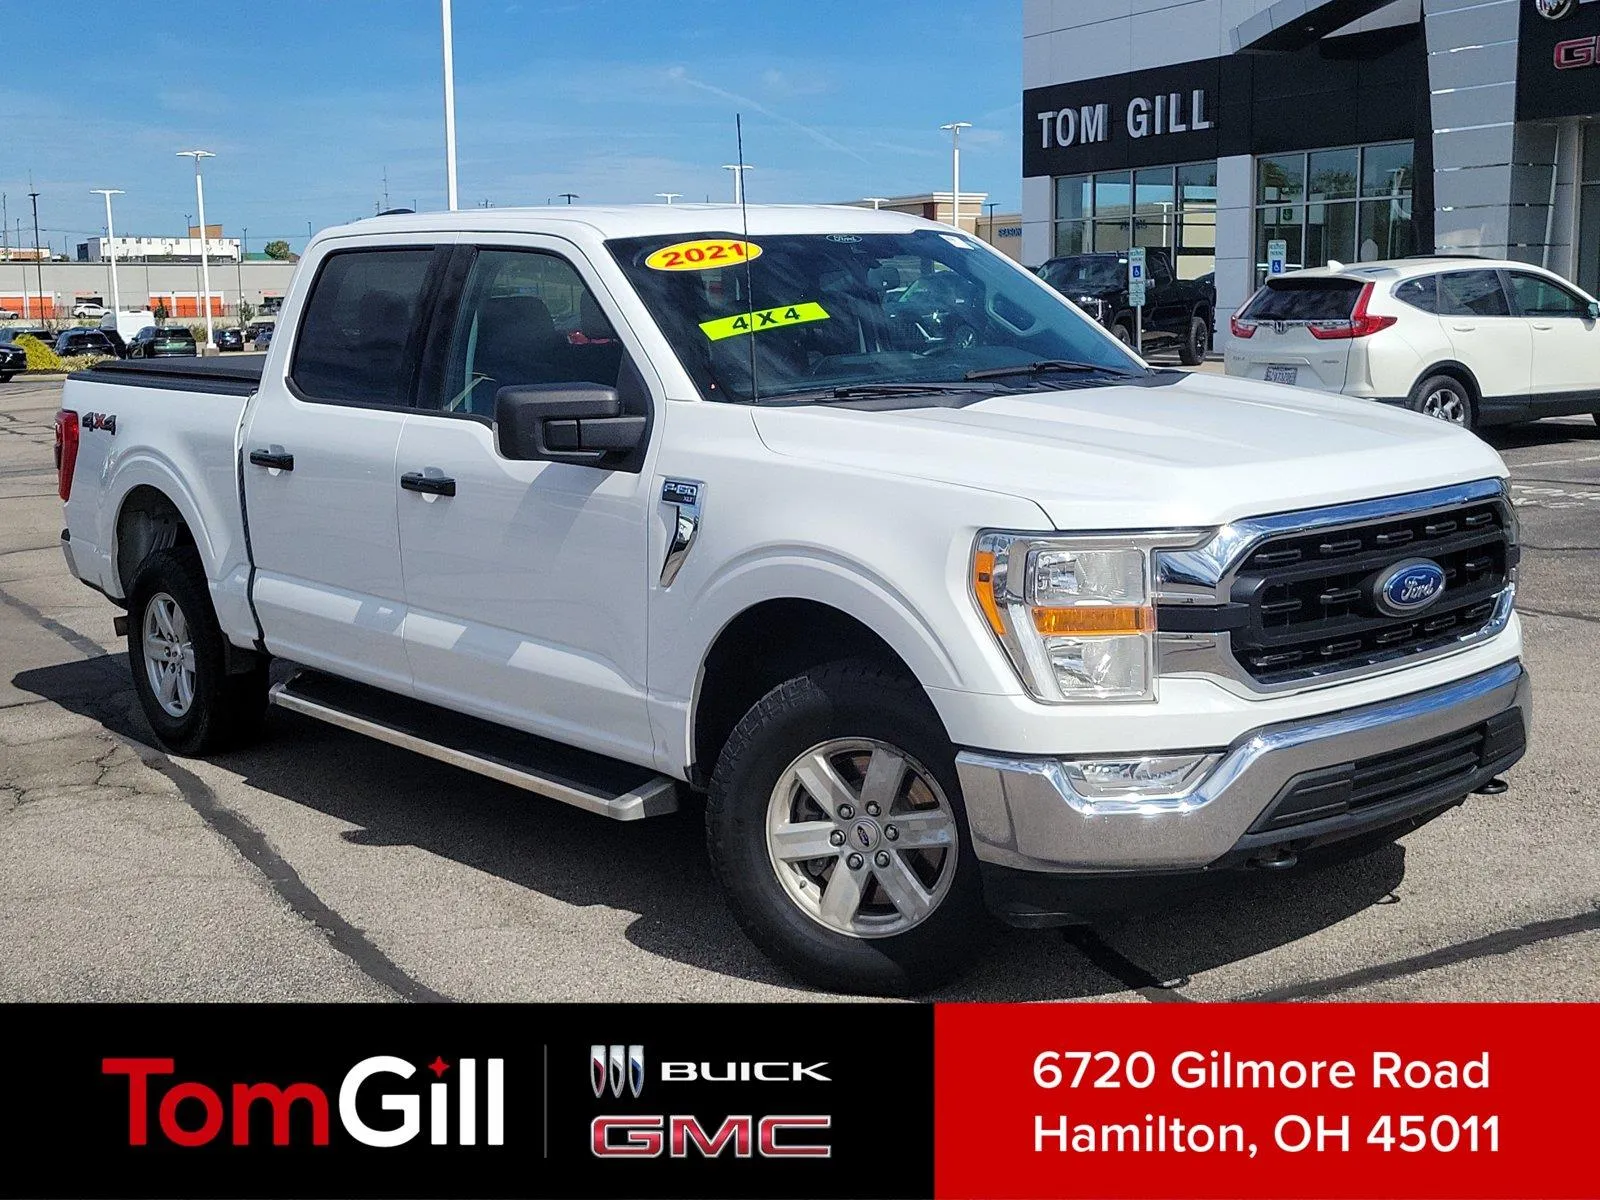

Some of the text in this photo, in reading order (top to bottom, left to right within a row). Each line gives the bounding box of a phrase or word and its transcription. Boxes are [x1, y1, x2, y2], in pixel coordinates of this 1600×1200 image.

[1553, 35, 1600, 70] G
[1037, 89, 1214, 149] TOM GILL
[661, 243, 745, 268] 2021
[1401, 574, 1434, 601] Ford
